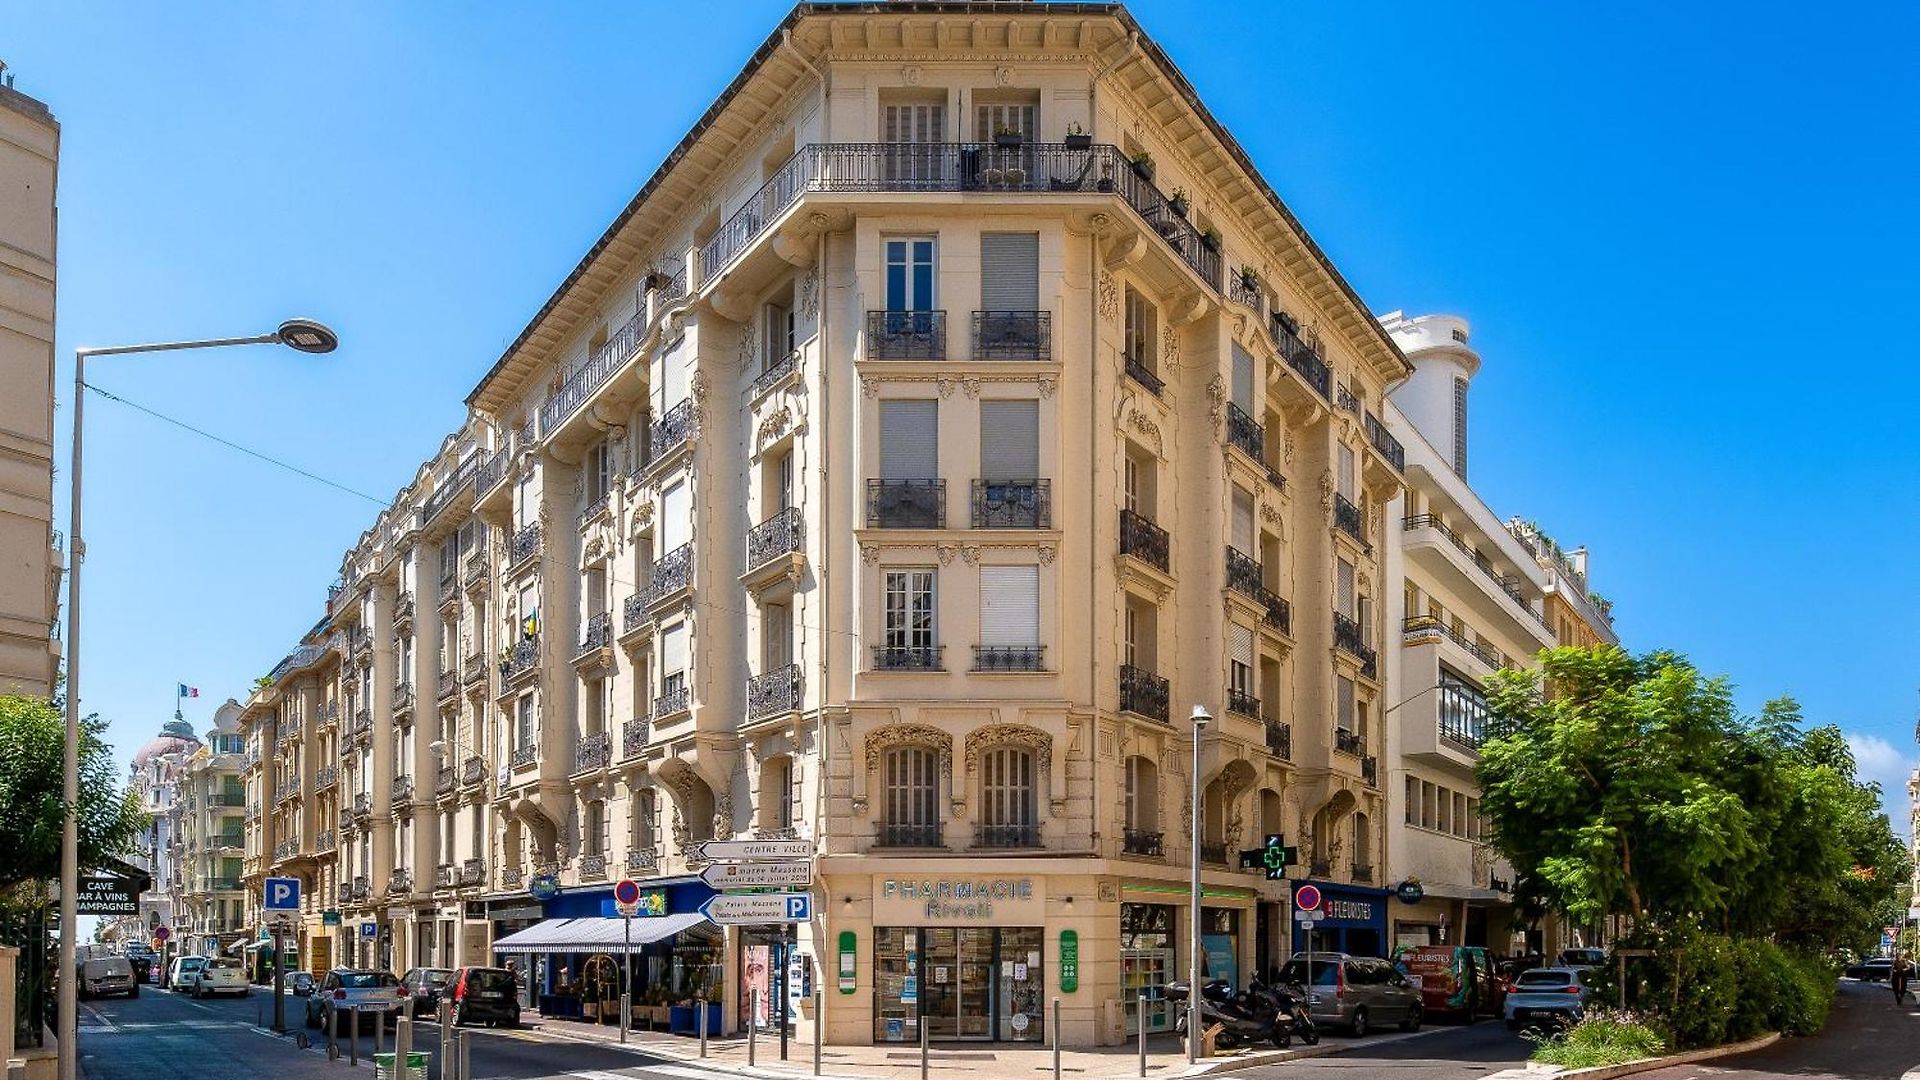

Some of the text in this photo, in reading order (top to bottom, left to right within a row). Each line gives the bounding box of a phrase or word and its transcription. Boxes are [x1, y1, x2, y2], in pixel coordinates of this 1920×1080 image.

[744, 845, 807, 853] CENTRE VILLE
[87, 882, 114, 890] CAVE
[884, 880, 1033, 900] PHARMACIE
[104, 893, 129, 901] VINS
[274, 883, 291, 904] P
[77, 902, 136, 911] AMPAGNES
[790, 899, 804, 917] P
[926, 900, 993, 919] Rivoli
[1334, 900, 1371, 919] FLEURISTES
[365, 925, 373, 935] P
